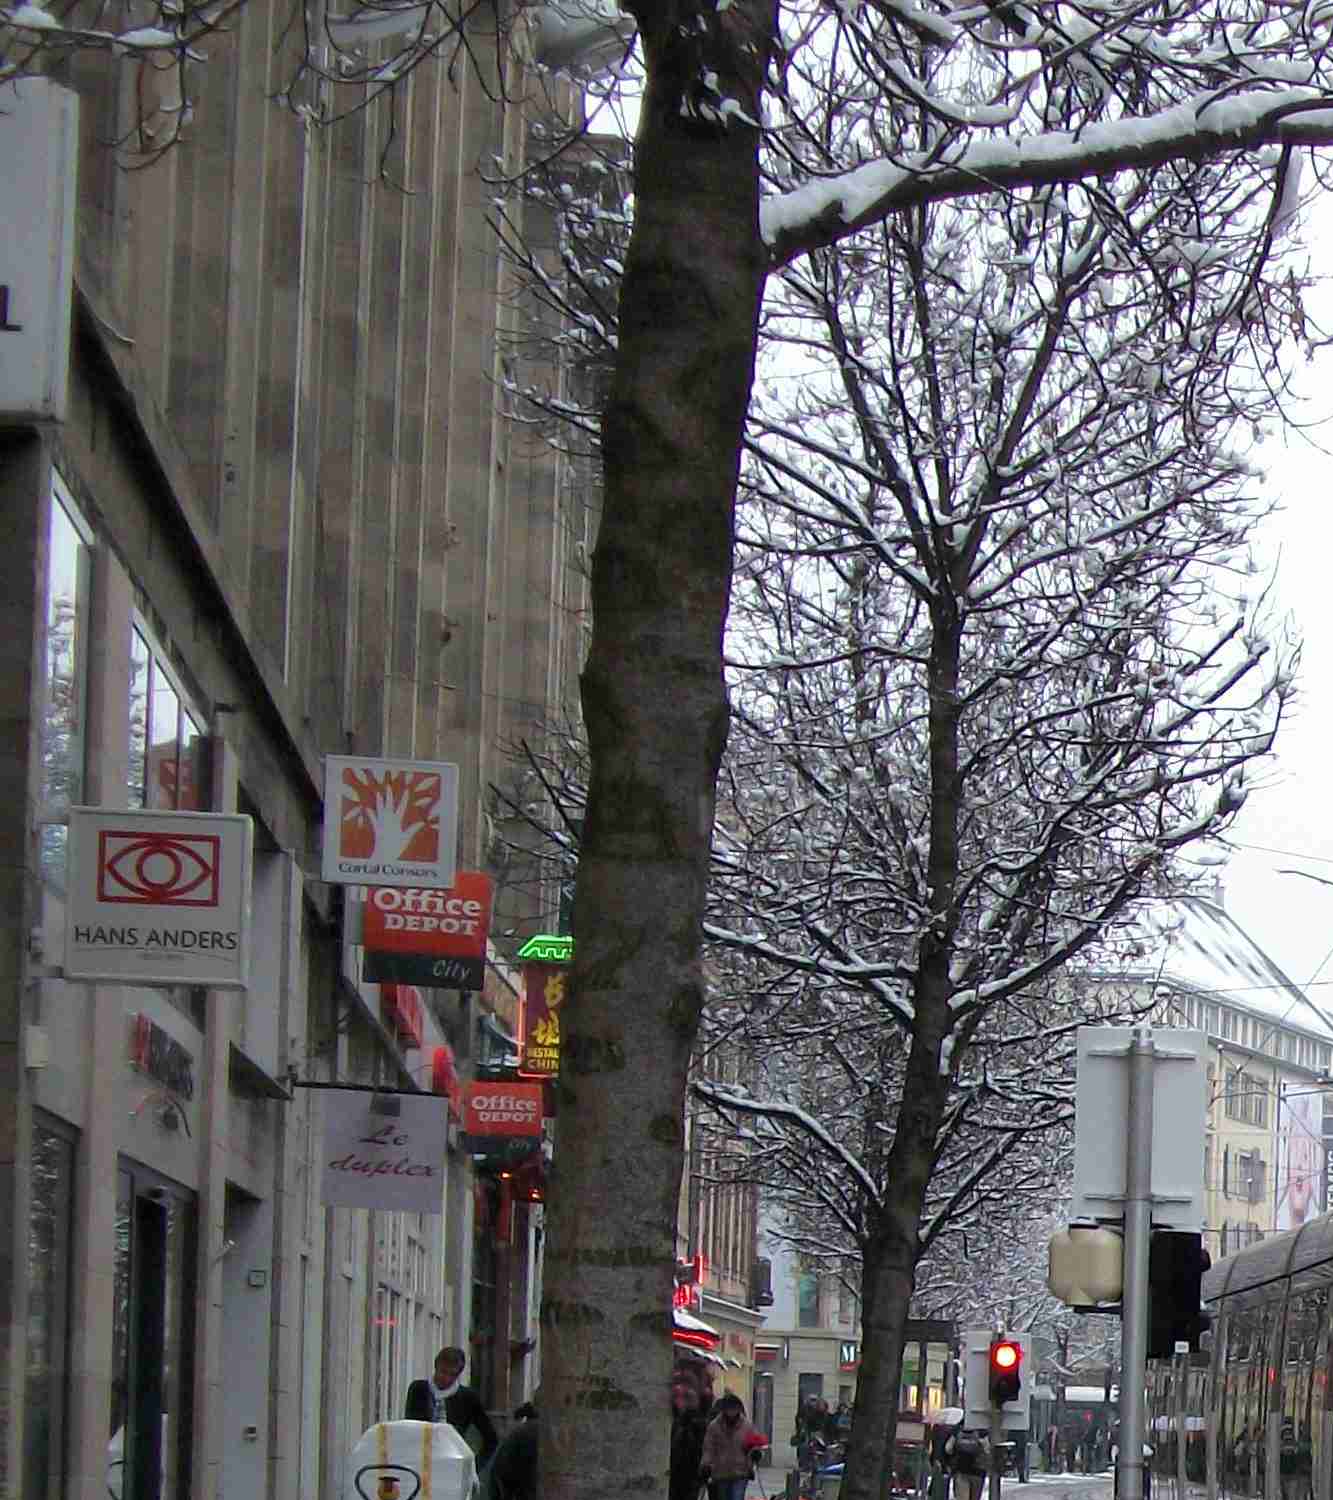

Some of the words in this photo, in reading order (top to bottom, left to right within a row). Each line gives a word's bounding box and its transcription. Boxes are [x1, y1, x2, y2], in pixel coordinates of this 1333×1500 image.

[373, 887, 481, 917] Office
[383, 913, 480, 936] DEPOT
[74, 925, 139, 946] HANS
[145, 927, 239, 950] ANDERS
[471, 1095, 537, 1112] Office
[478, 1110, 536, 1123] DEPOT
